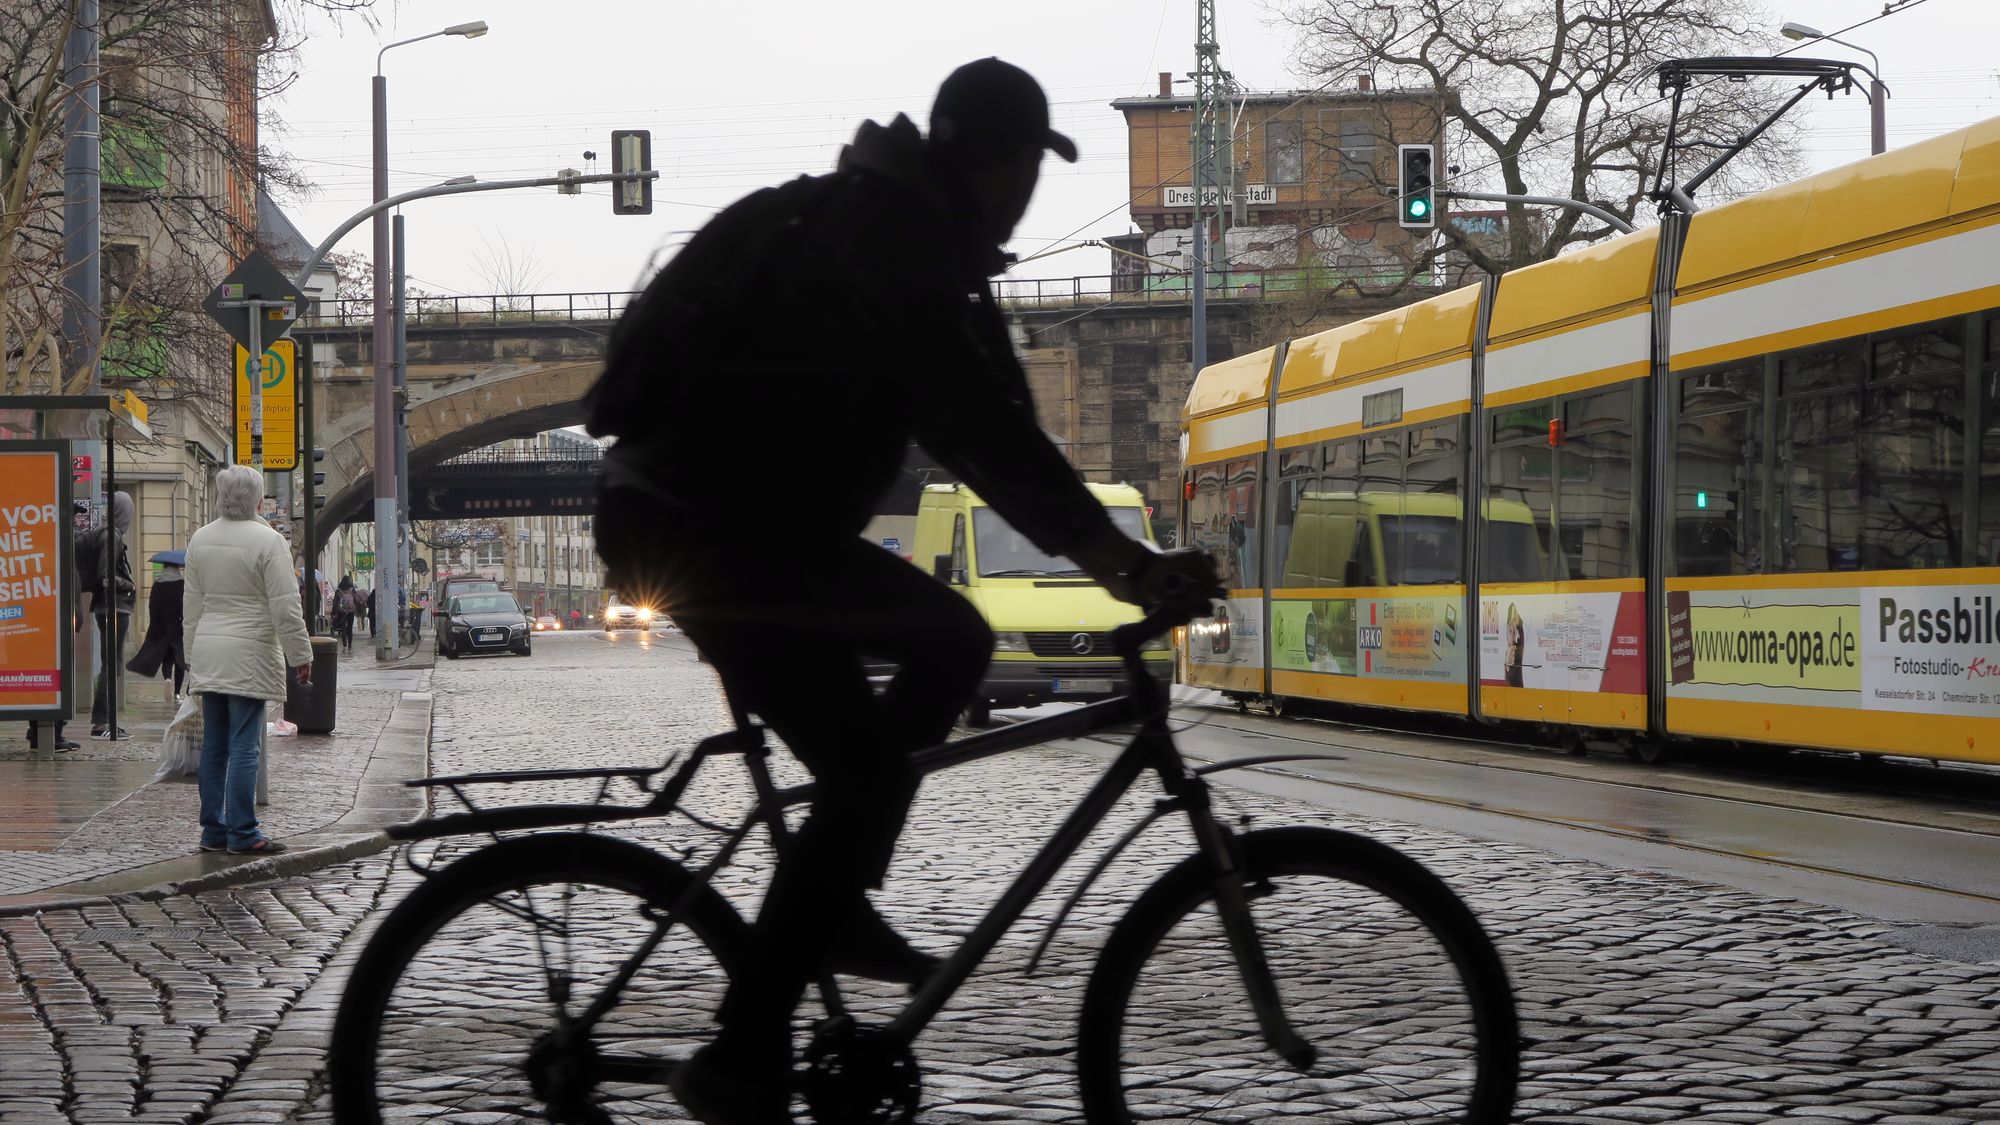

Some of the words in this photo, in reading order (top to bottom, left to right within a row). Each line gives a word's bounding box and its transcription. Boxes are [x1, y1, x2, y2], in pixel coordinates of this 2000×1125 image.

[2, 504, 56, 528] VOR
[1360, 629, 1382, 647] ARKO
[1694, 616, 1855, 678] www.oma-opa.de
